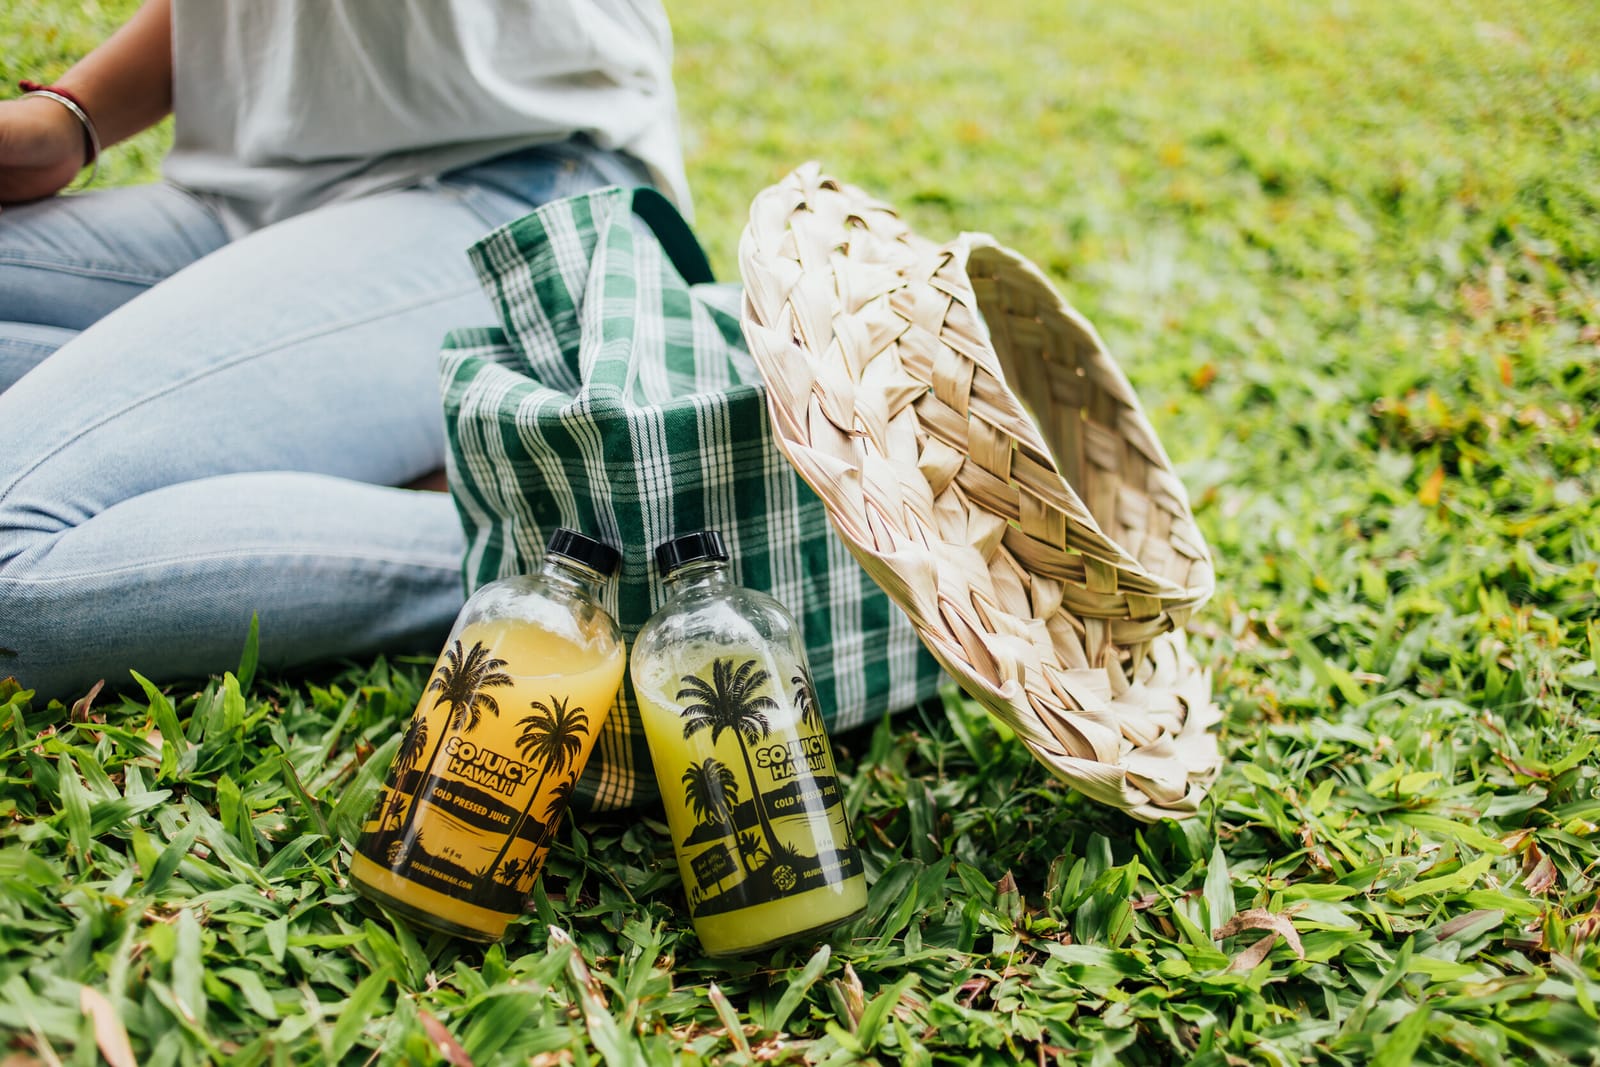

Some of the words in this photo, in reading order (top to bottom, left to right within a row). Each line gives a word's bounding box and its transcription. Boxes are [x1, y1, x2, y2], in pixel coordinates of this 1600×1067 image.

[432, 787, 453, 801] COLD
[453, 796, 488, 816] PRESSED
[488, 811, 511, 825] JUICE
[774, 797, 795, 809] COLD
